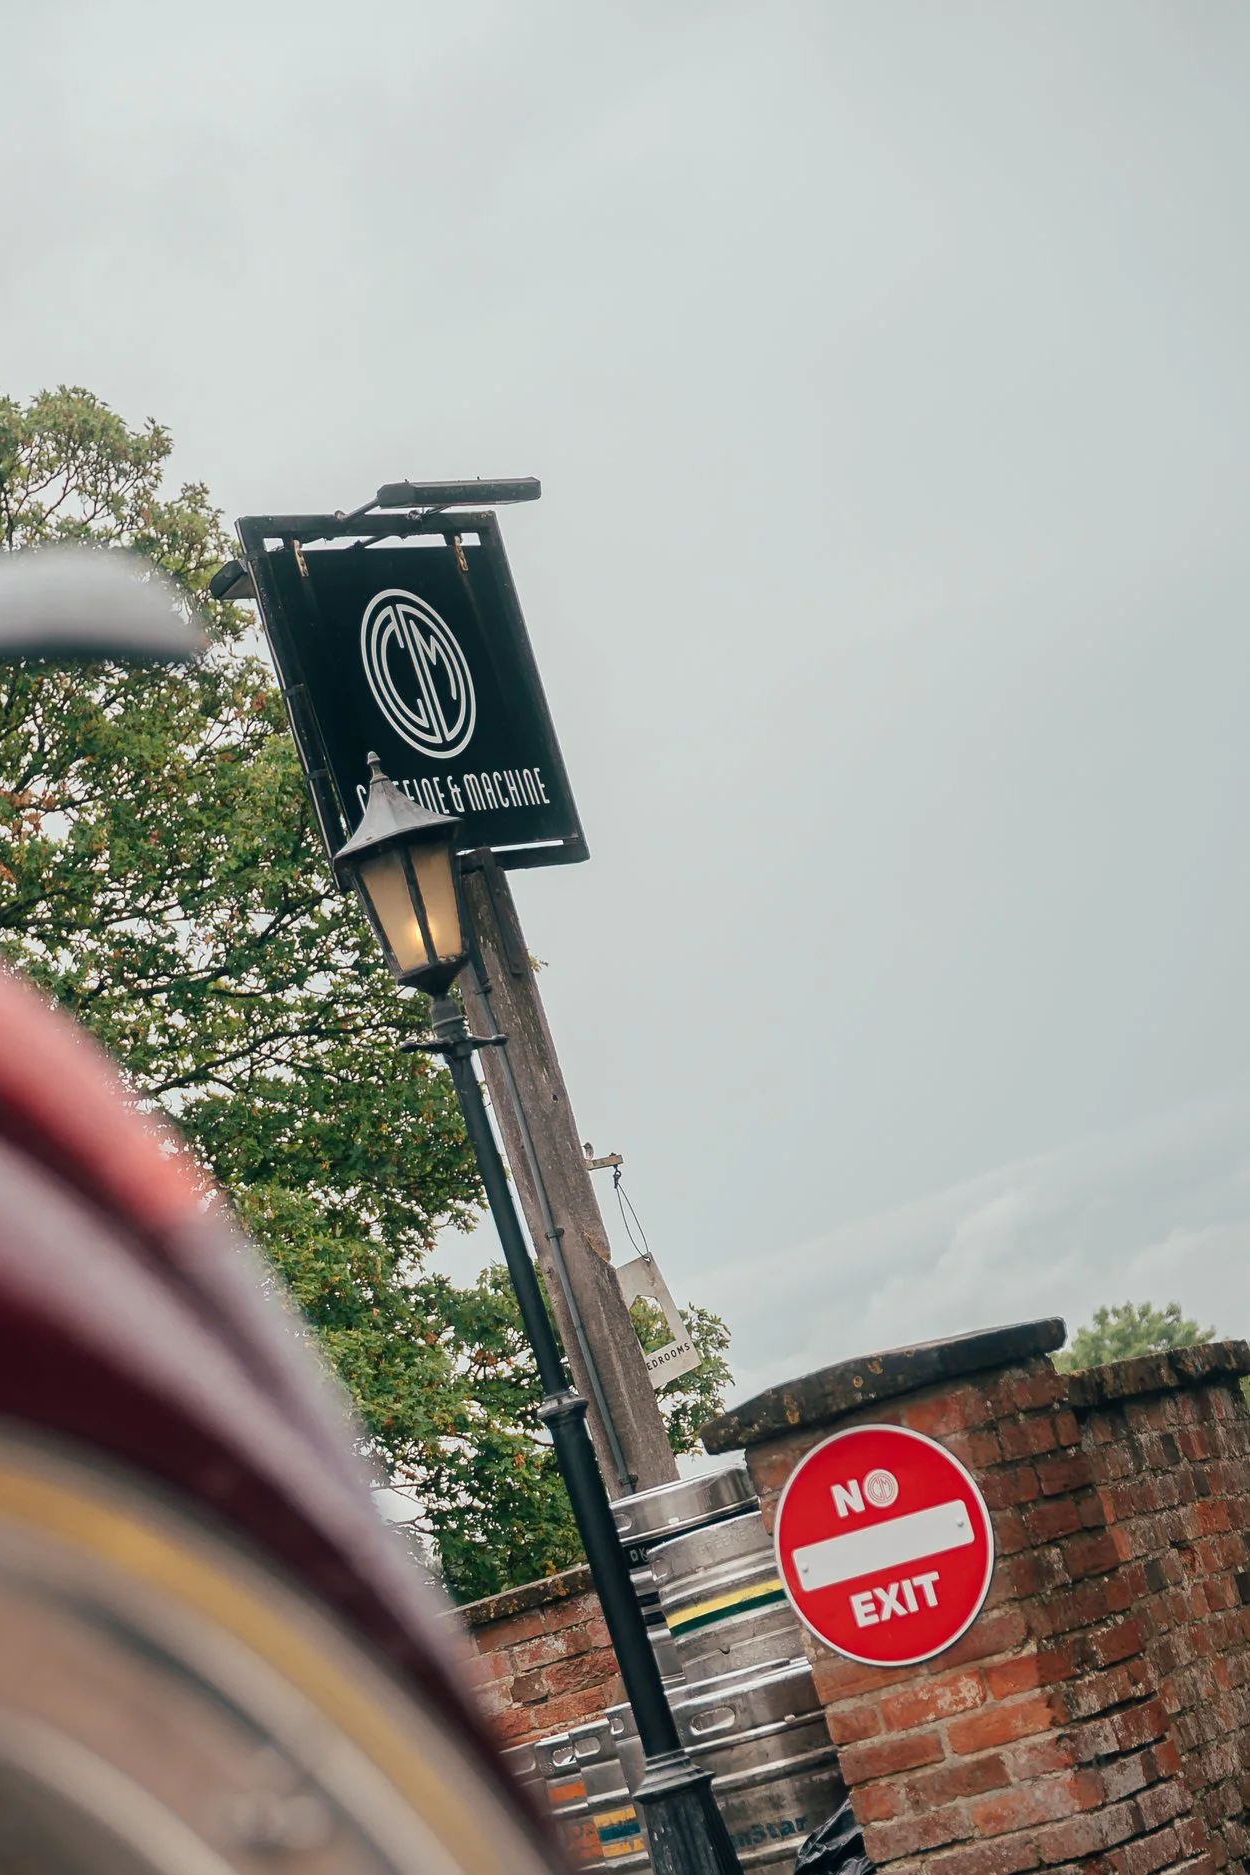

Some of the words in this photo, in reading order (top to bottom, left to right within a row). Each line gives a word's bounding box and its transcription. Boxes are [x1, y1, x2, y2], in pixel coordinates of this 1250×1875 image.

[447, 775, 465, 813] &
[463, 767, 550, 812] MACHINE
[646, 1342, 691, 1371] EDROOMS
[830, 1468, 899, 1518] NO
[850, 1571, 940, 1628] EXIT
